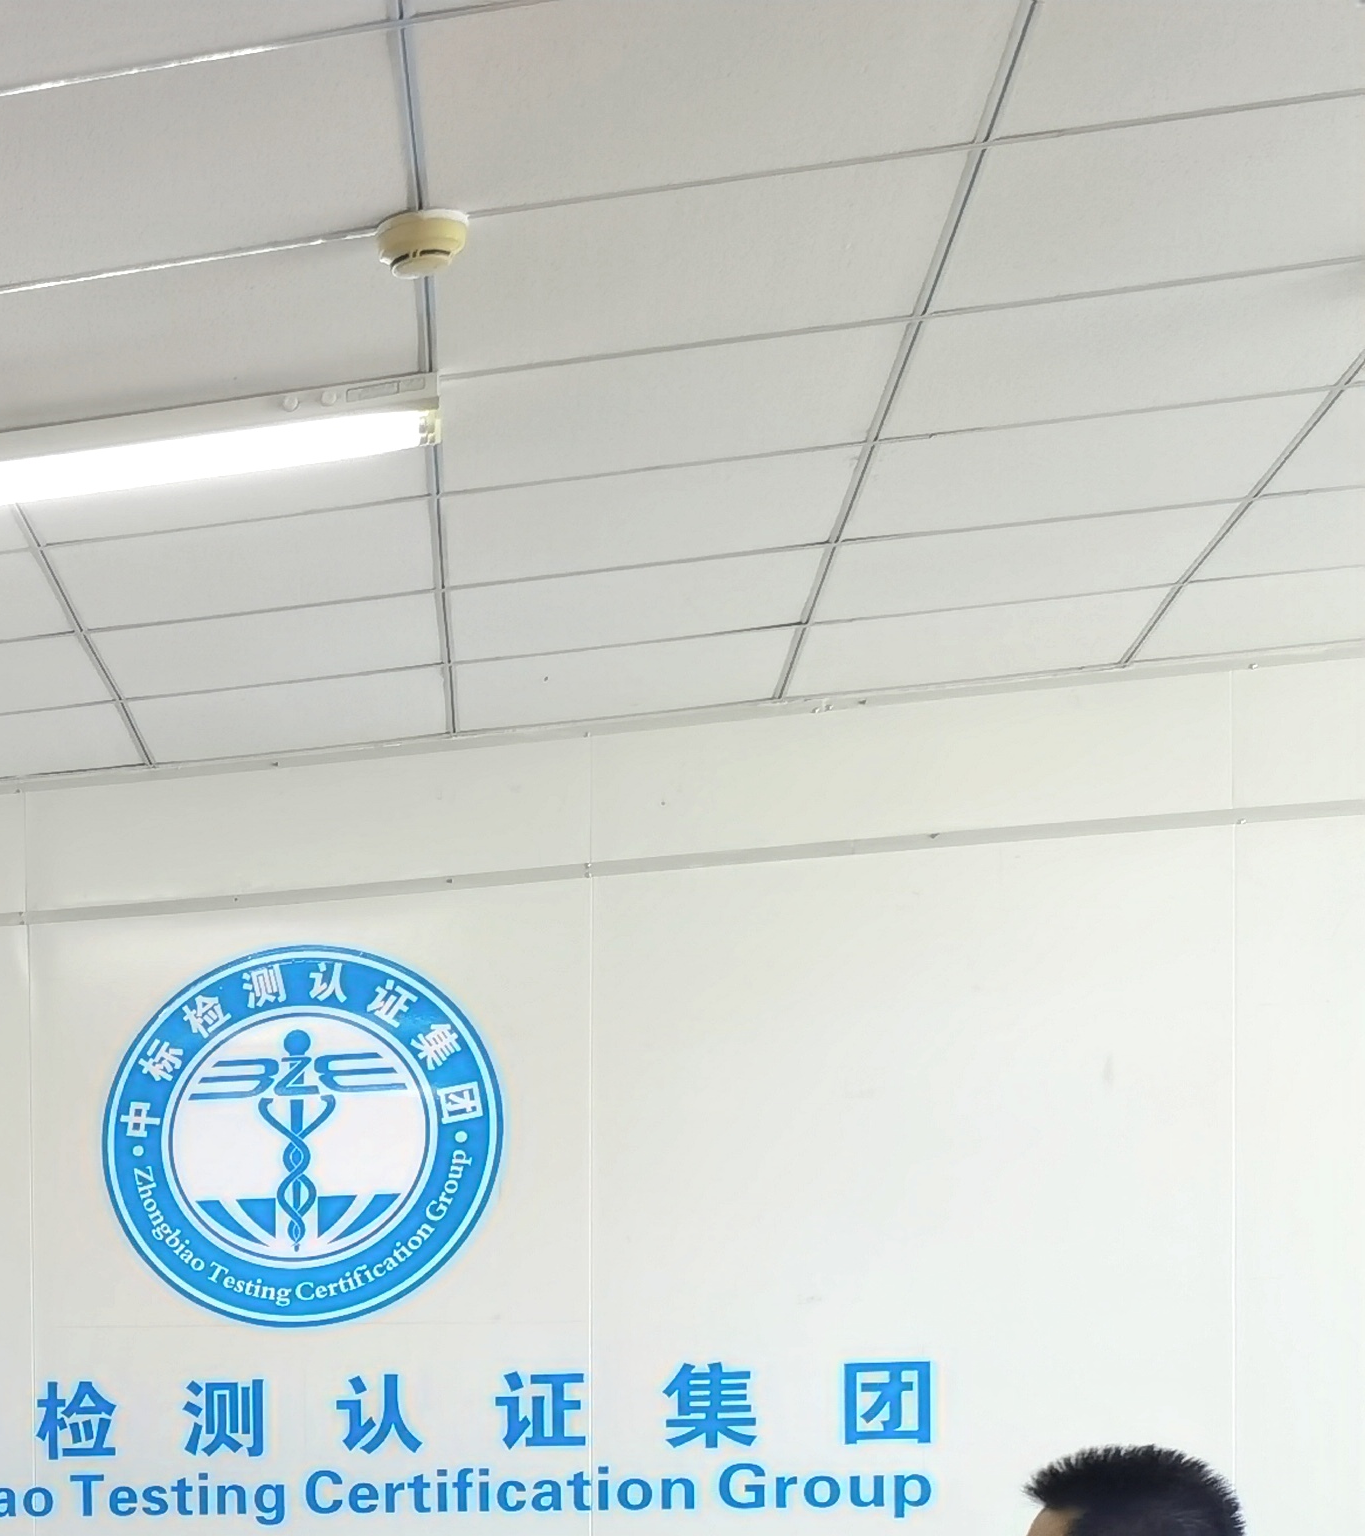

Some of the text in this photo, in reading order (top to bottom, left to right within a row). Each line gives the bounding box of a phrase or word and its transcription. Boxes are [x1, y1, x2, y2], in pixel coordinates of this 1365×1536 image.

[120, 960, 484, 1138] 中标检测认证集团
[133, 1148, 473, 1307] Zhongbiao Testing Certification Group
[69, 1474, 287, 1526] Testing
[305, 1467, 697, 1515] Certification
[718, 1462, 933, 1518] Group
